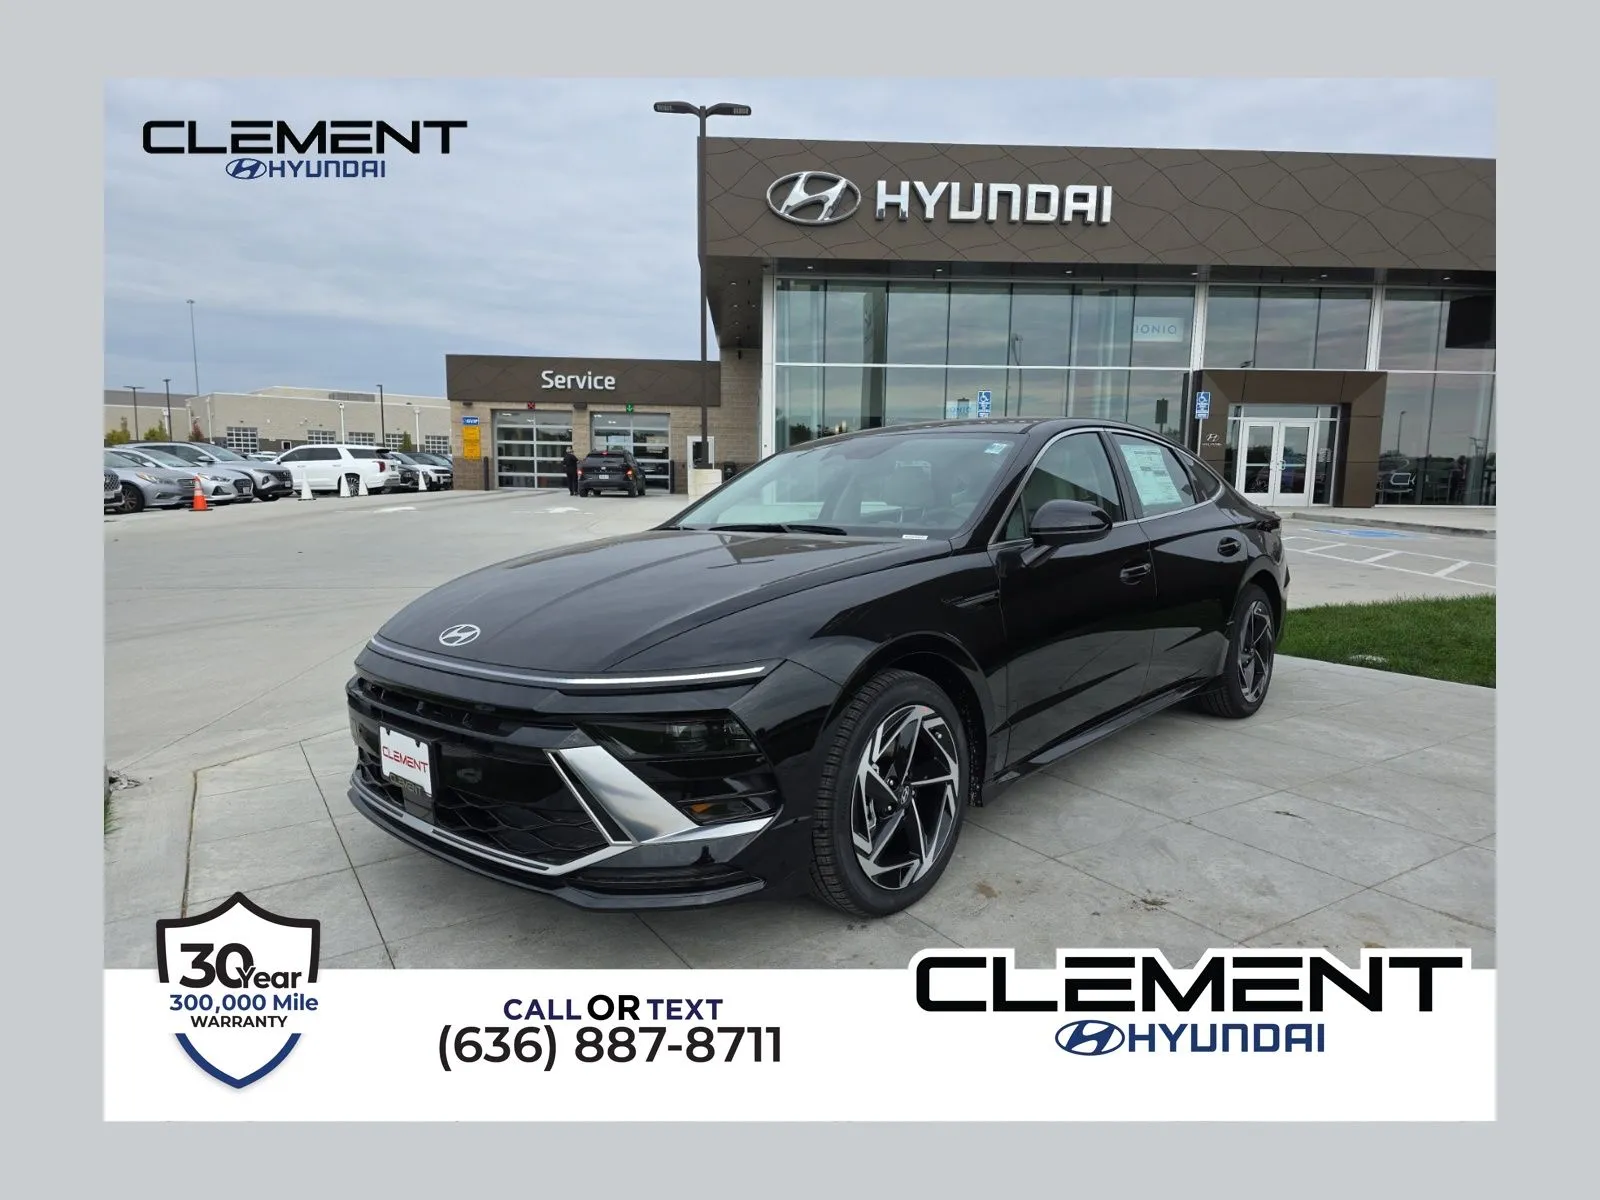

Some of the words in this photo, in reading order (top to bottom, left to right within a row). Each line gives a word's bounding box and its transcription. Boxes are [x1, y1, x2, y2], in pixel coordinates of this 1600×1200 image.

[876, 179, 1113, 225] HYUNDAI
[541, 370, 616, 390] Service
[382, 745, 428, 773] CLEMENT
